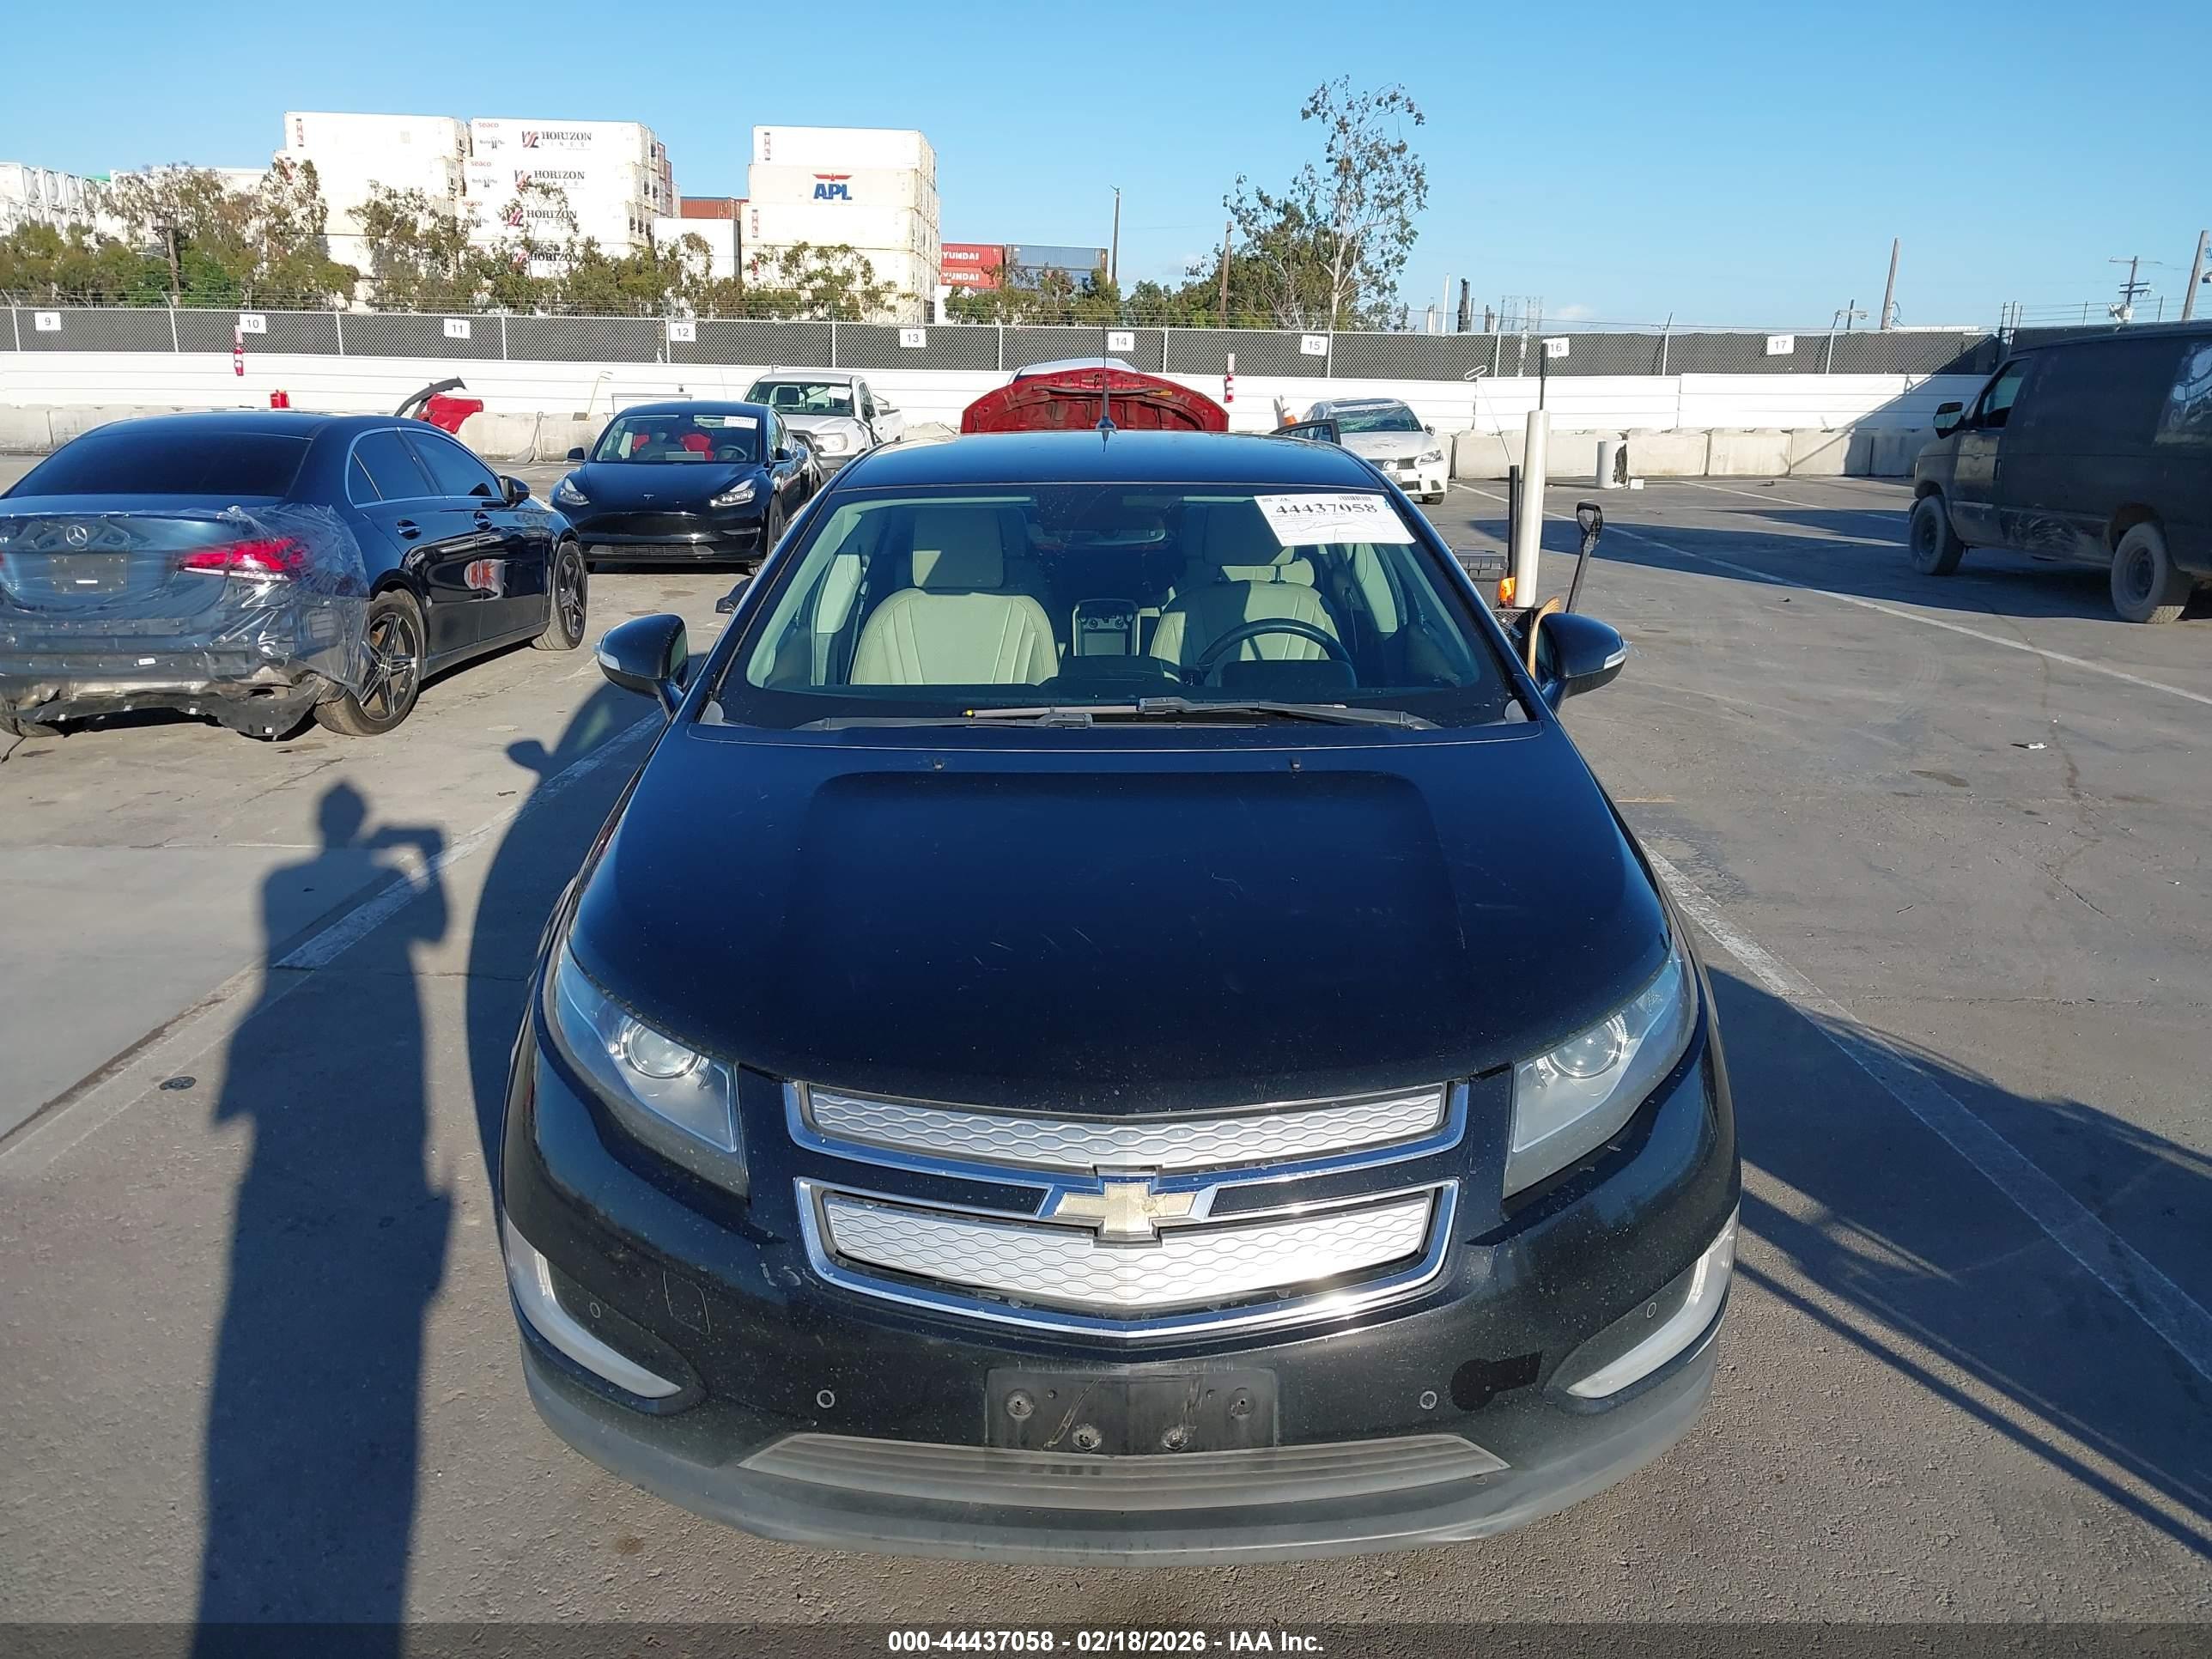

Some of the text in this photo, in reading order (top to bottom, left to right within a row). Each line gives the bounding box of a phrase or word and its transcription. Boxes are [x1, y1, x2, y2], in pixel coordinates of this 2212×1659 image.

[541, 131, 592, 141] HORIZON
[533, 170, 585, 179] HORIZON
[813, 183, 853, 200] APL
[526, 210, 577, 219] HORIZON
[941, 251, 979, 261] YUNDAI
[45, 317, 52, 325] 9
[246, 319, 259, 329] 10
[453, 324, 463, 334] 11
[677, 328, 689, 337] 12
[907, 333, 920, 343] 13
[1115, 337, 1127, 346] 14
[1308, 341, 1321, 350] 15
[1551, 343, 1562, 352] 16
[1775, 340, 1787, 349] 17
[1276, 503, 1378, 514] 44437058
